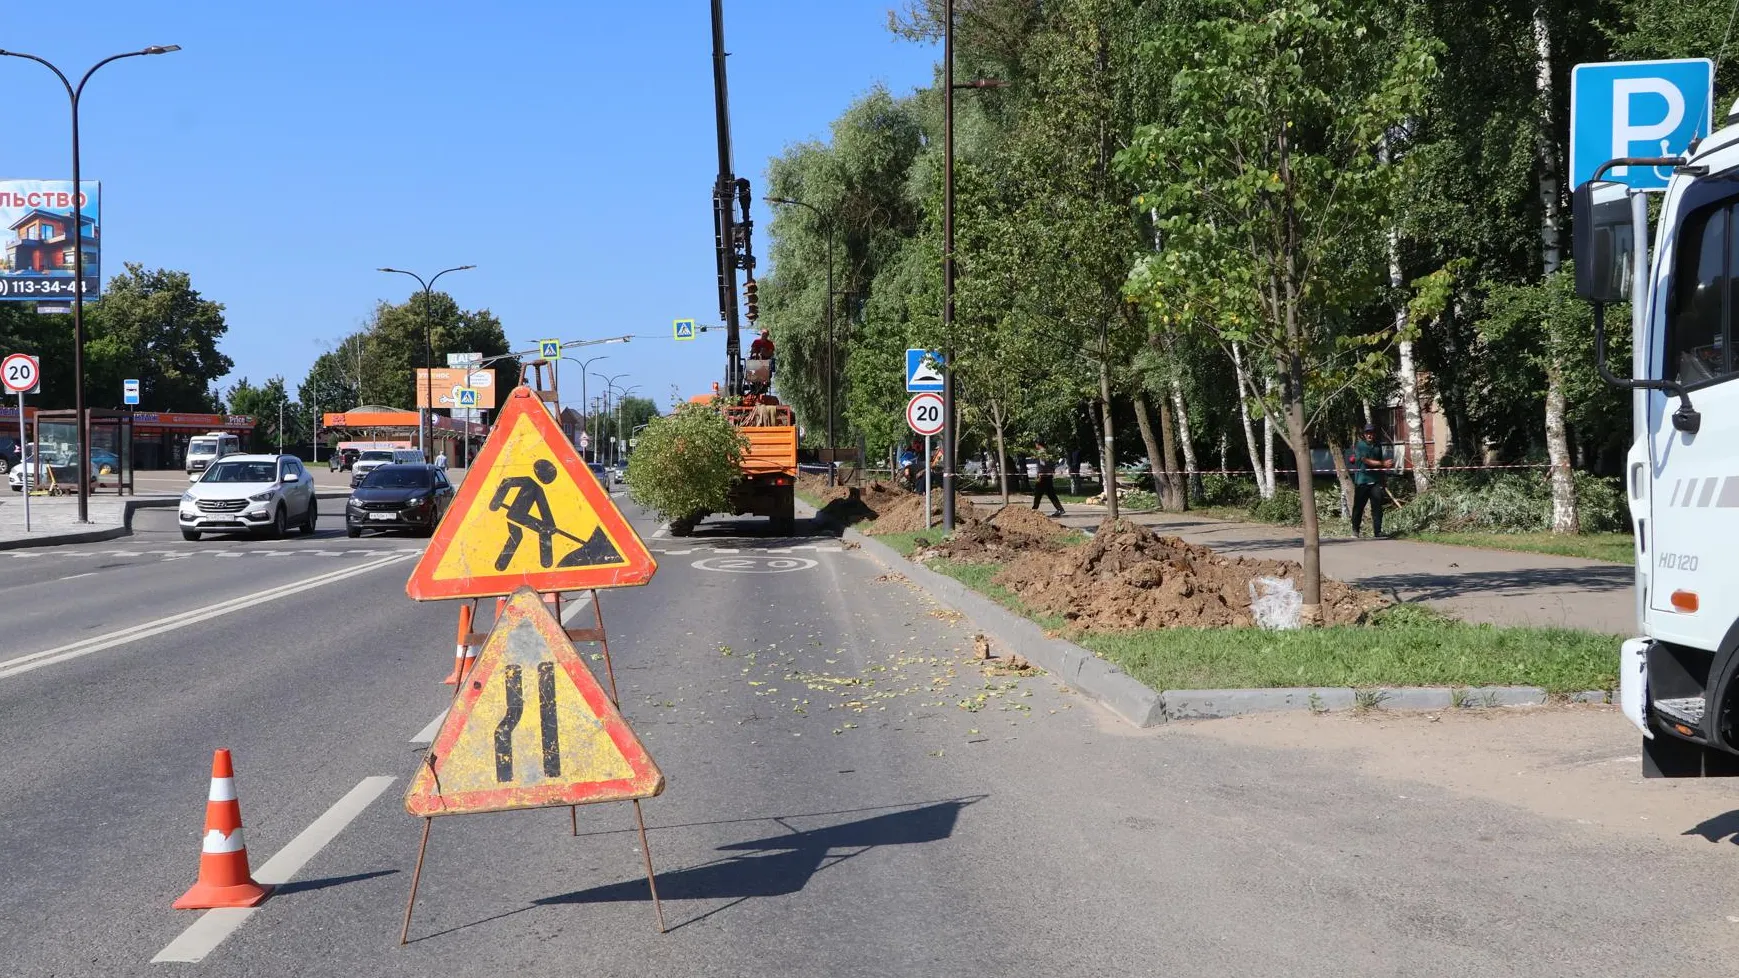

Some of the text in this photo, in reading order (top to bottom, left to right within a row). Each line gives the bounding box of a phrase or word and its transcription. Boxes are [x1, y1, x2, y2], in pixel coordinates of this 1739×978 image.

[1611, 77, 1685, 177] P
[9, 365, 30, 380] 20
[916, 405, 939, 422] 20
[717, 560, 798, 568] 20
